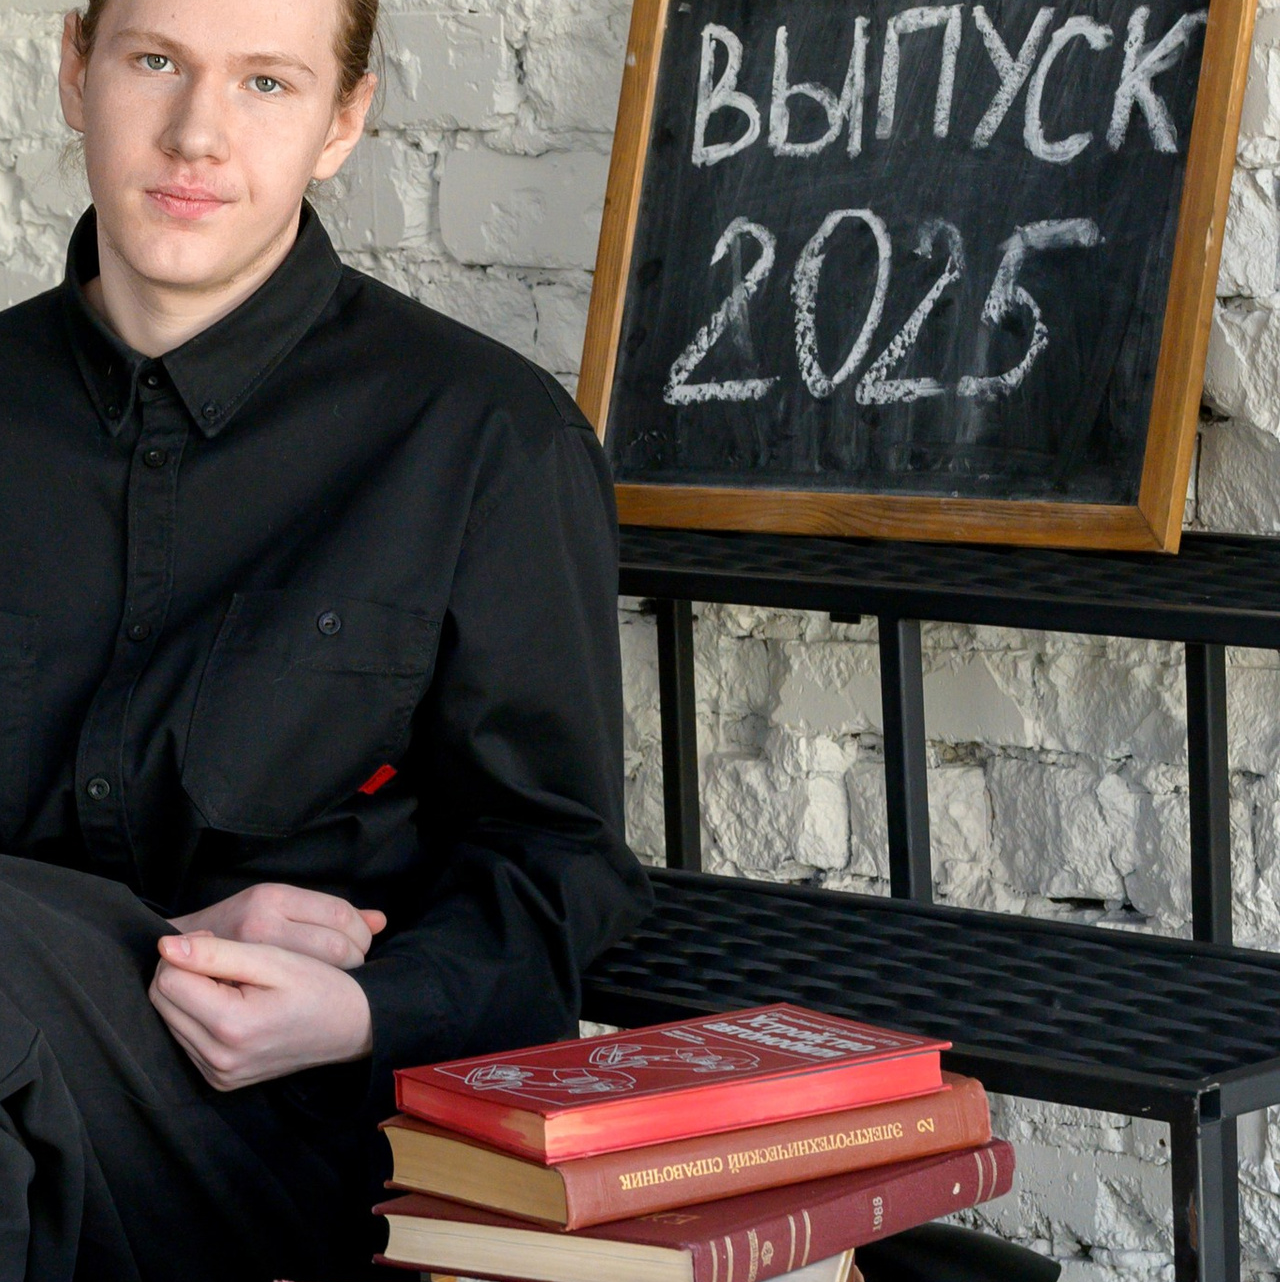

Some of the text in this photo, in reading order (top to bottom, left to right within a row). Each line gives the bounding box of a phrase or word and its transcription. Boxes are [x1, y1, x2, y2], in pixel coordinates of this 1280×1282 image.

[692, 4, 1208, 167] ВЫПУСК
[663, 208, 1105, 405] 2025
[619, 1122, 903, 1191] ЭЛЕКТРОТЕХНИЧЕСКИЙ СПРАВОЧНИК
[917, 1118, 934, 1133] 2
[872, 1196, 884, 1232] 1988
